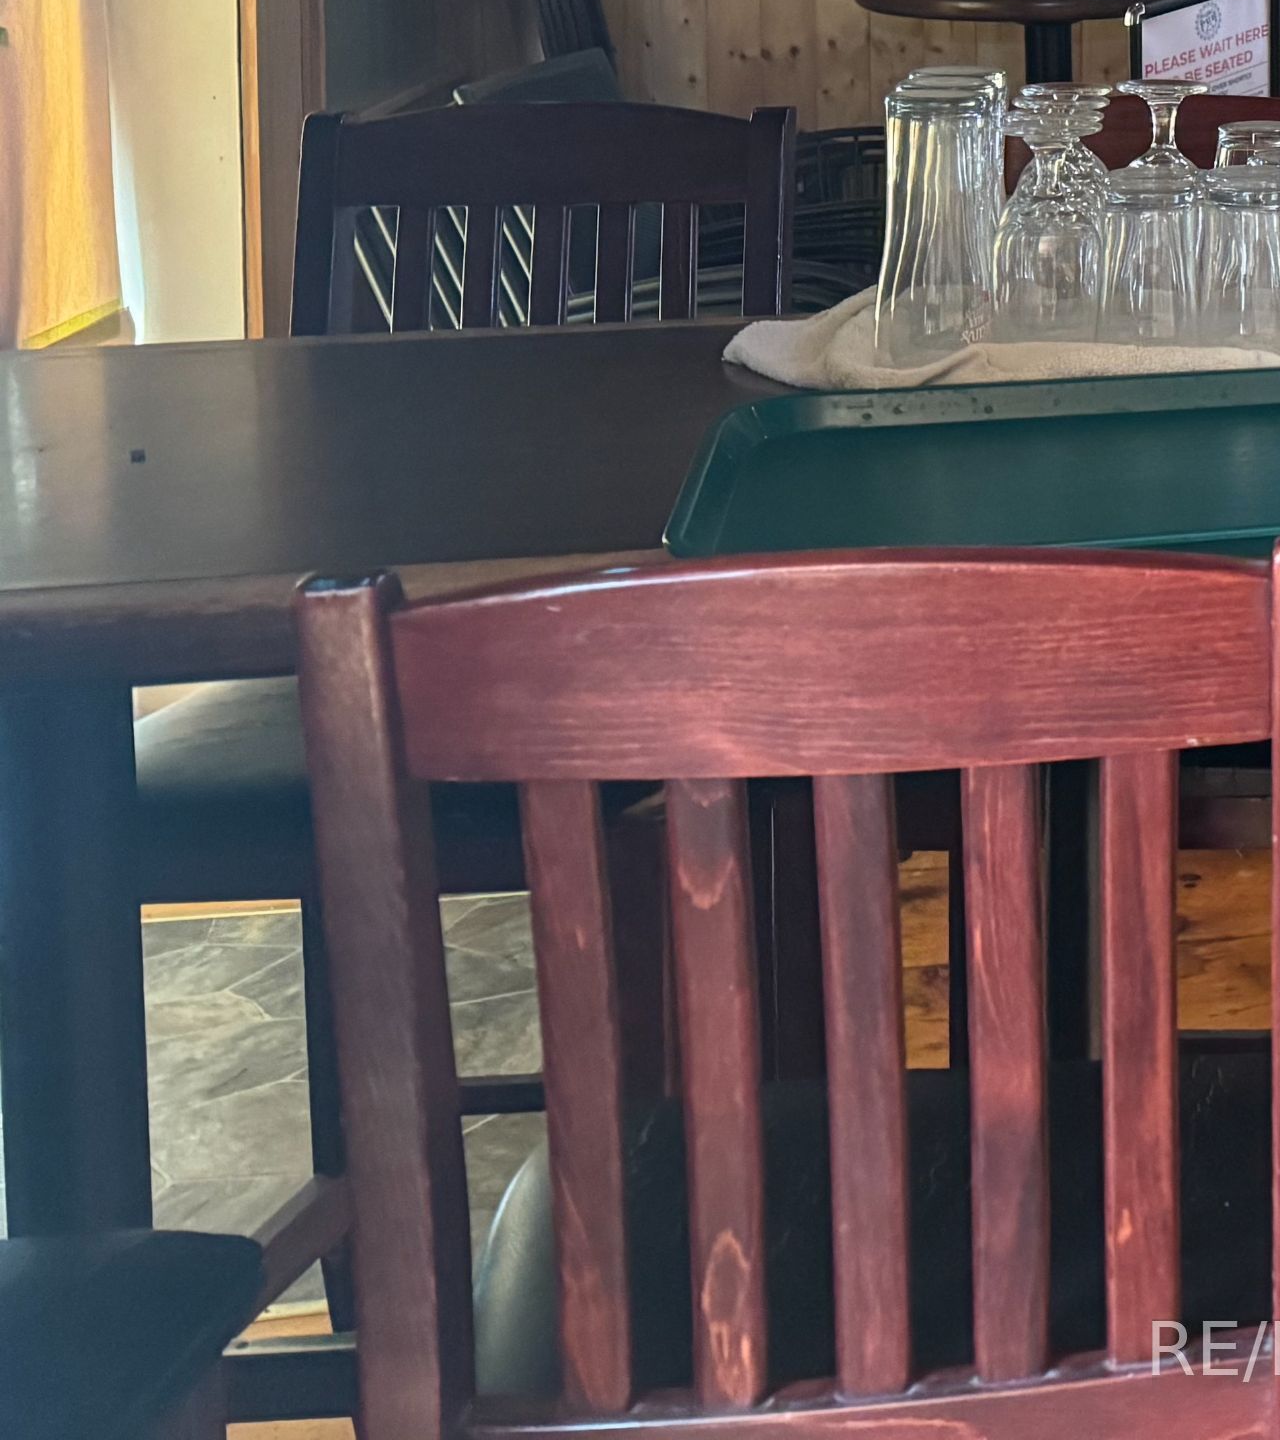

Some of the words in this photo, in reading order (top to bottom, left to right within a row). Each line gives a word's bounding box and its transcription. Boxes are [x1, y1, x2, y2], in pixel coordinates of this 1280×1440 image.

[1144, 49, 1197, 78] PLEASE
[1199, 36, 1235, 59] WAIT
[1235, 23, 1270, 47] HERE
[1204, 50, 1254, 79] SEATED
